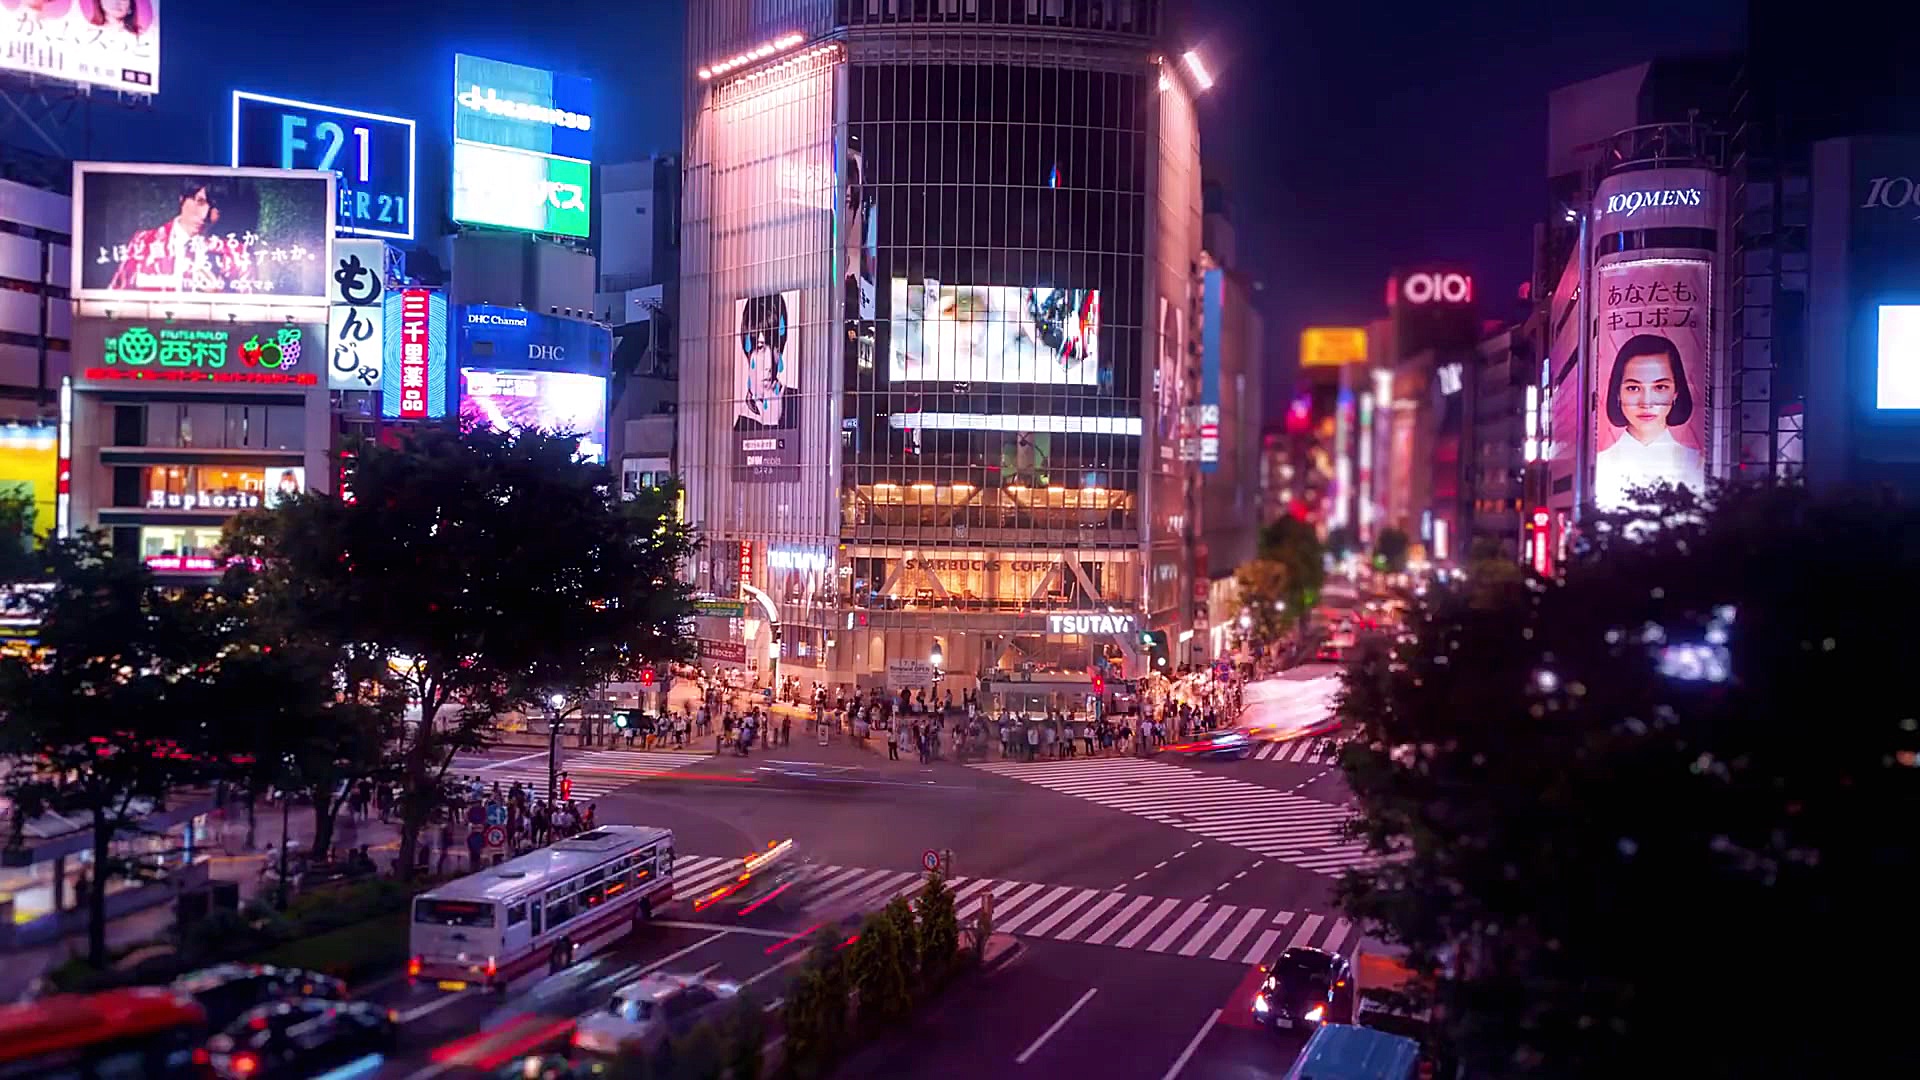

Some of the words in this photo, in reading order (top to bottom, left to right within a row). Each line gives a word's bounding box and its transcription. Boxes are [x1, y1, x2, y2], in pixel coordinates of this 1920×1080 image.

[282, 114, 369, 182] F21
[377, 194, 404, 225] 21
[1607, 280, 1698, 306] あなたも、
[333, 254, 381, 387] もんじゃ
[468, 314, 490, 325] DHC
[490, 315, 527, 327] Channel
[160, 340, 228, 369] 西村
[402, 296, 426, 412] 三千里薬品
[528, 343, 565, 361] DHC
